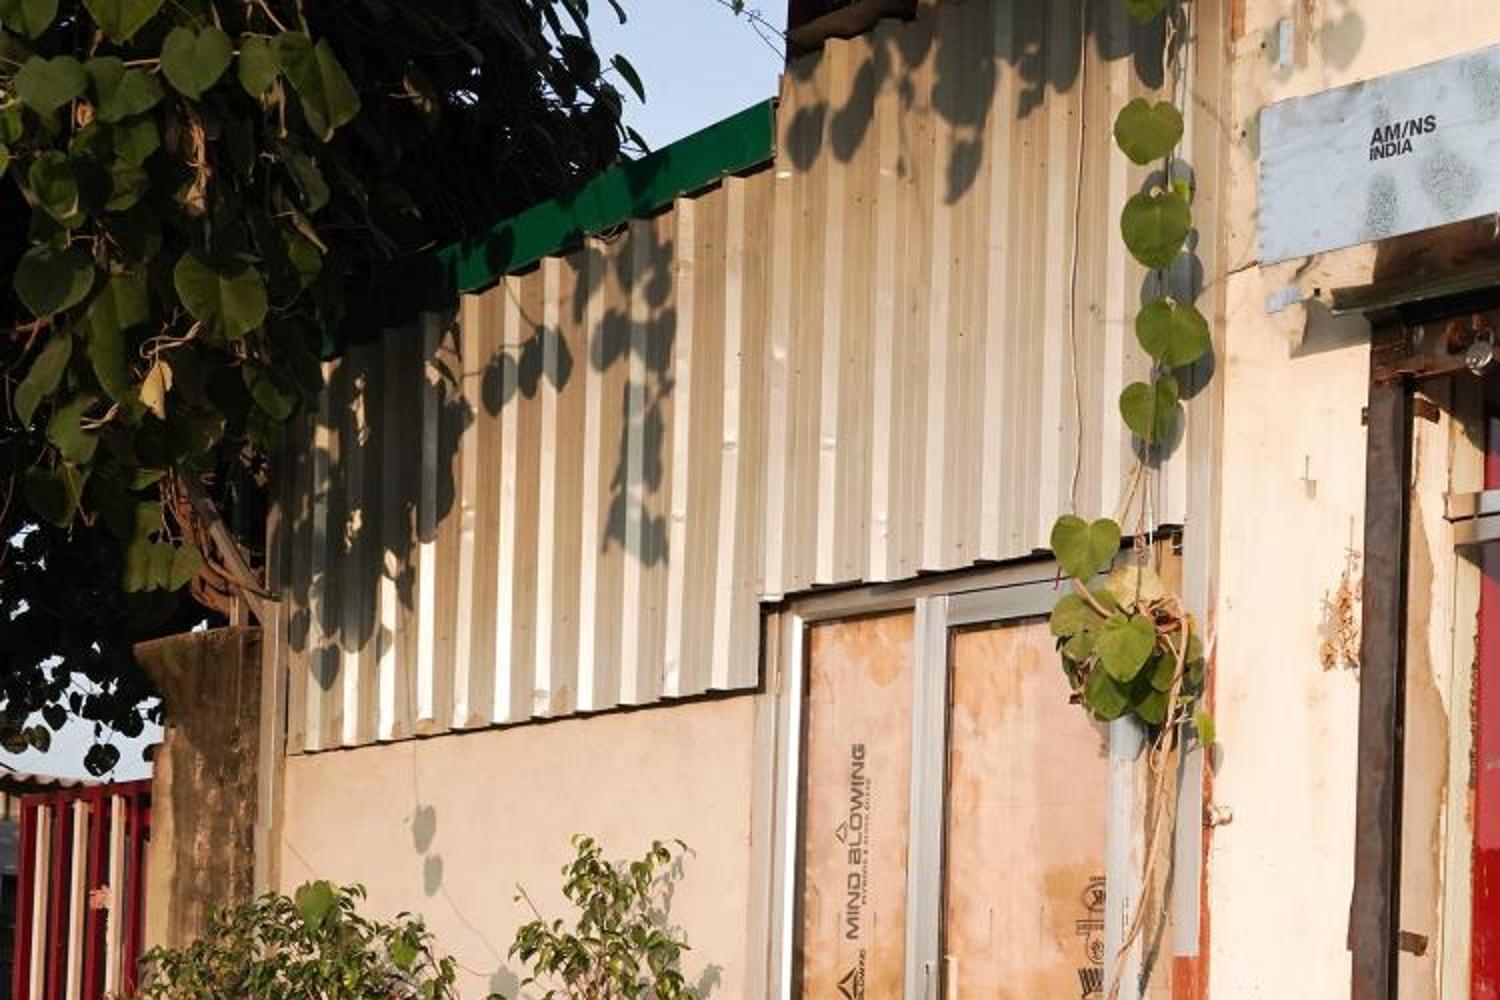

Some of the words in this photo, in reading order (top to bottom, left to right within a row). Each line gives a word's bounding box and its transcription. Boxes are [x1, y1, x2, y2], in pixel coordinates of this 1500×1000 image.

[1369, 138, 1413, 161] INDIA
[1370, 114, 1437, 146] AM/NS
[847, 743, 866, 865] BLOWING
[845, 872, 861, 940] MIND
